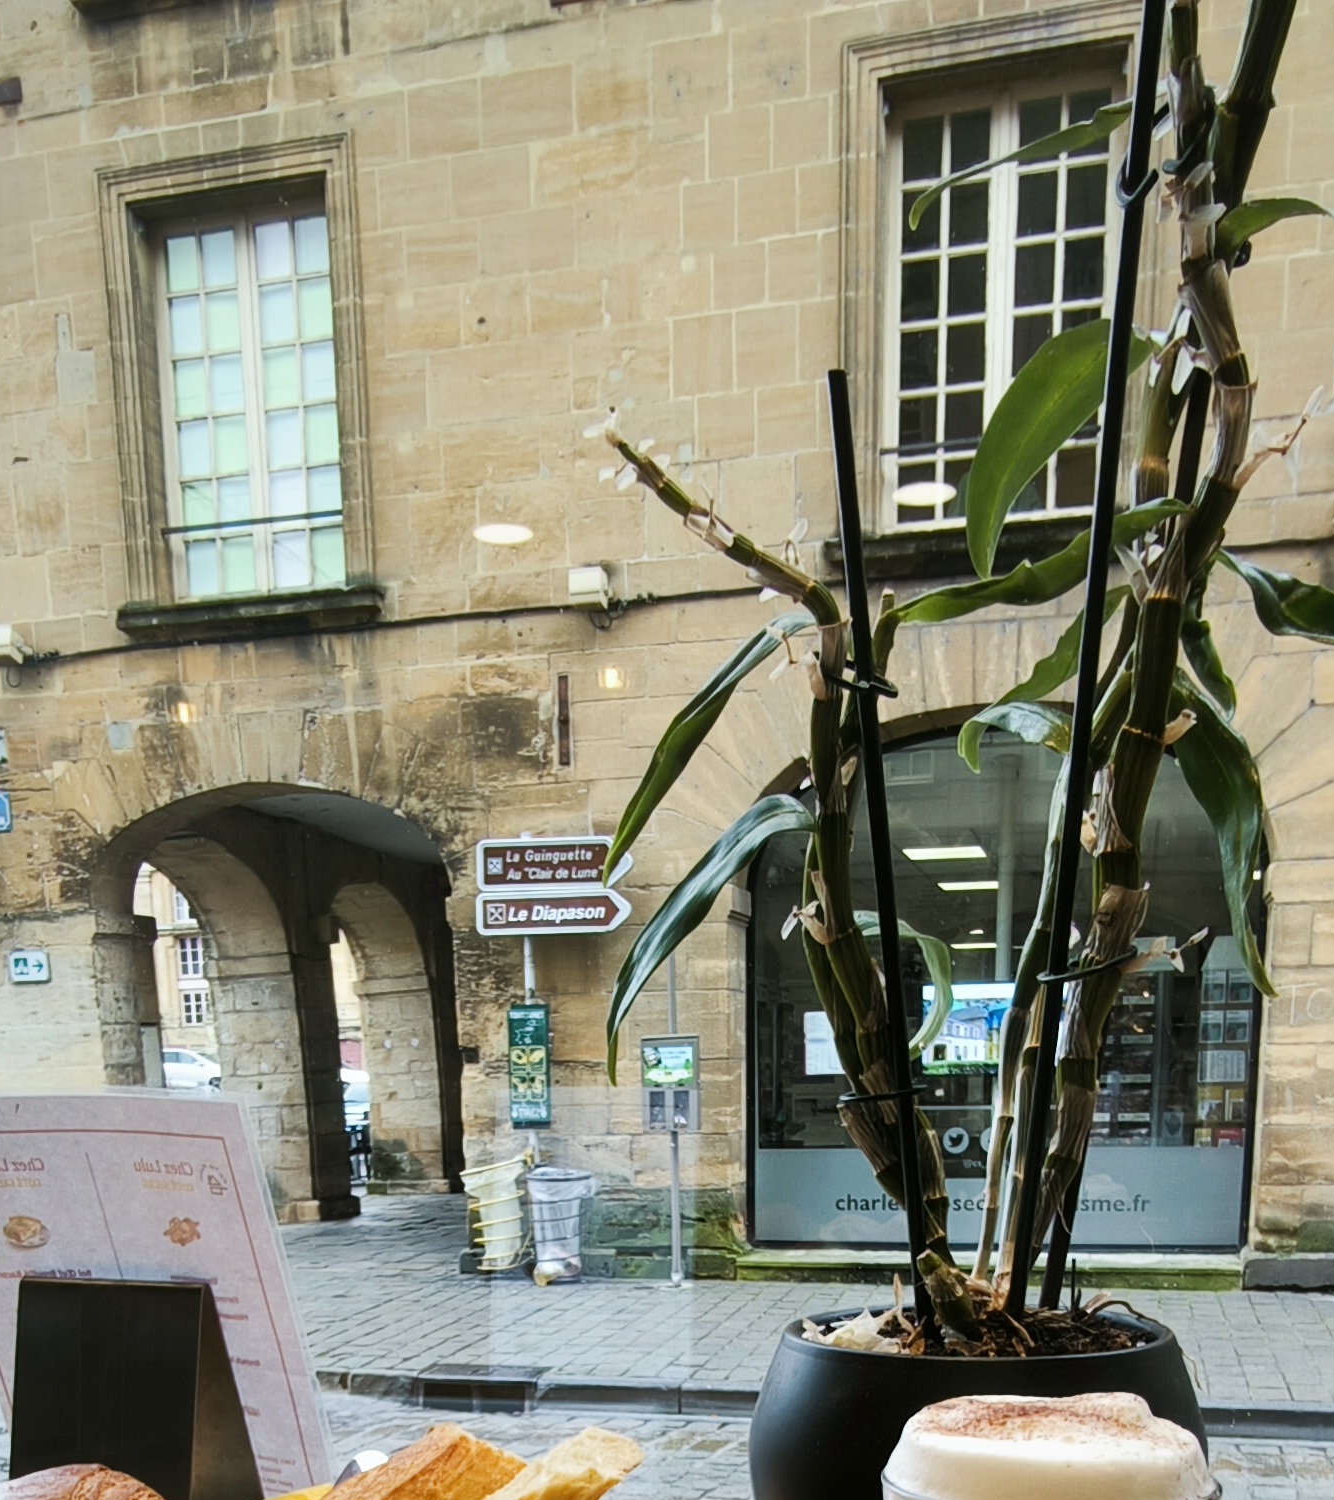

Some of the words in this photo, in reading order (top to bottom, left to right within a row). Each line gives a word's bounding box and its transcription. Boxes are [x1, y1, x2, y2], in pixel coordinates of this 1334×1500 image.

[524, 846, 593, 864] Guinguette
[506, 868, 522, 881] Au
[554, 865, 569, 879] de
[508, 907, 528, 922] Le
[531, 905, 606, 923] Diapason
